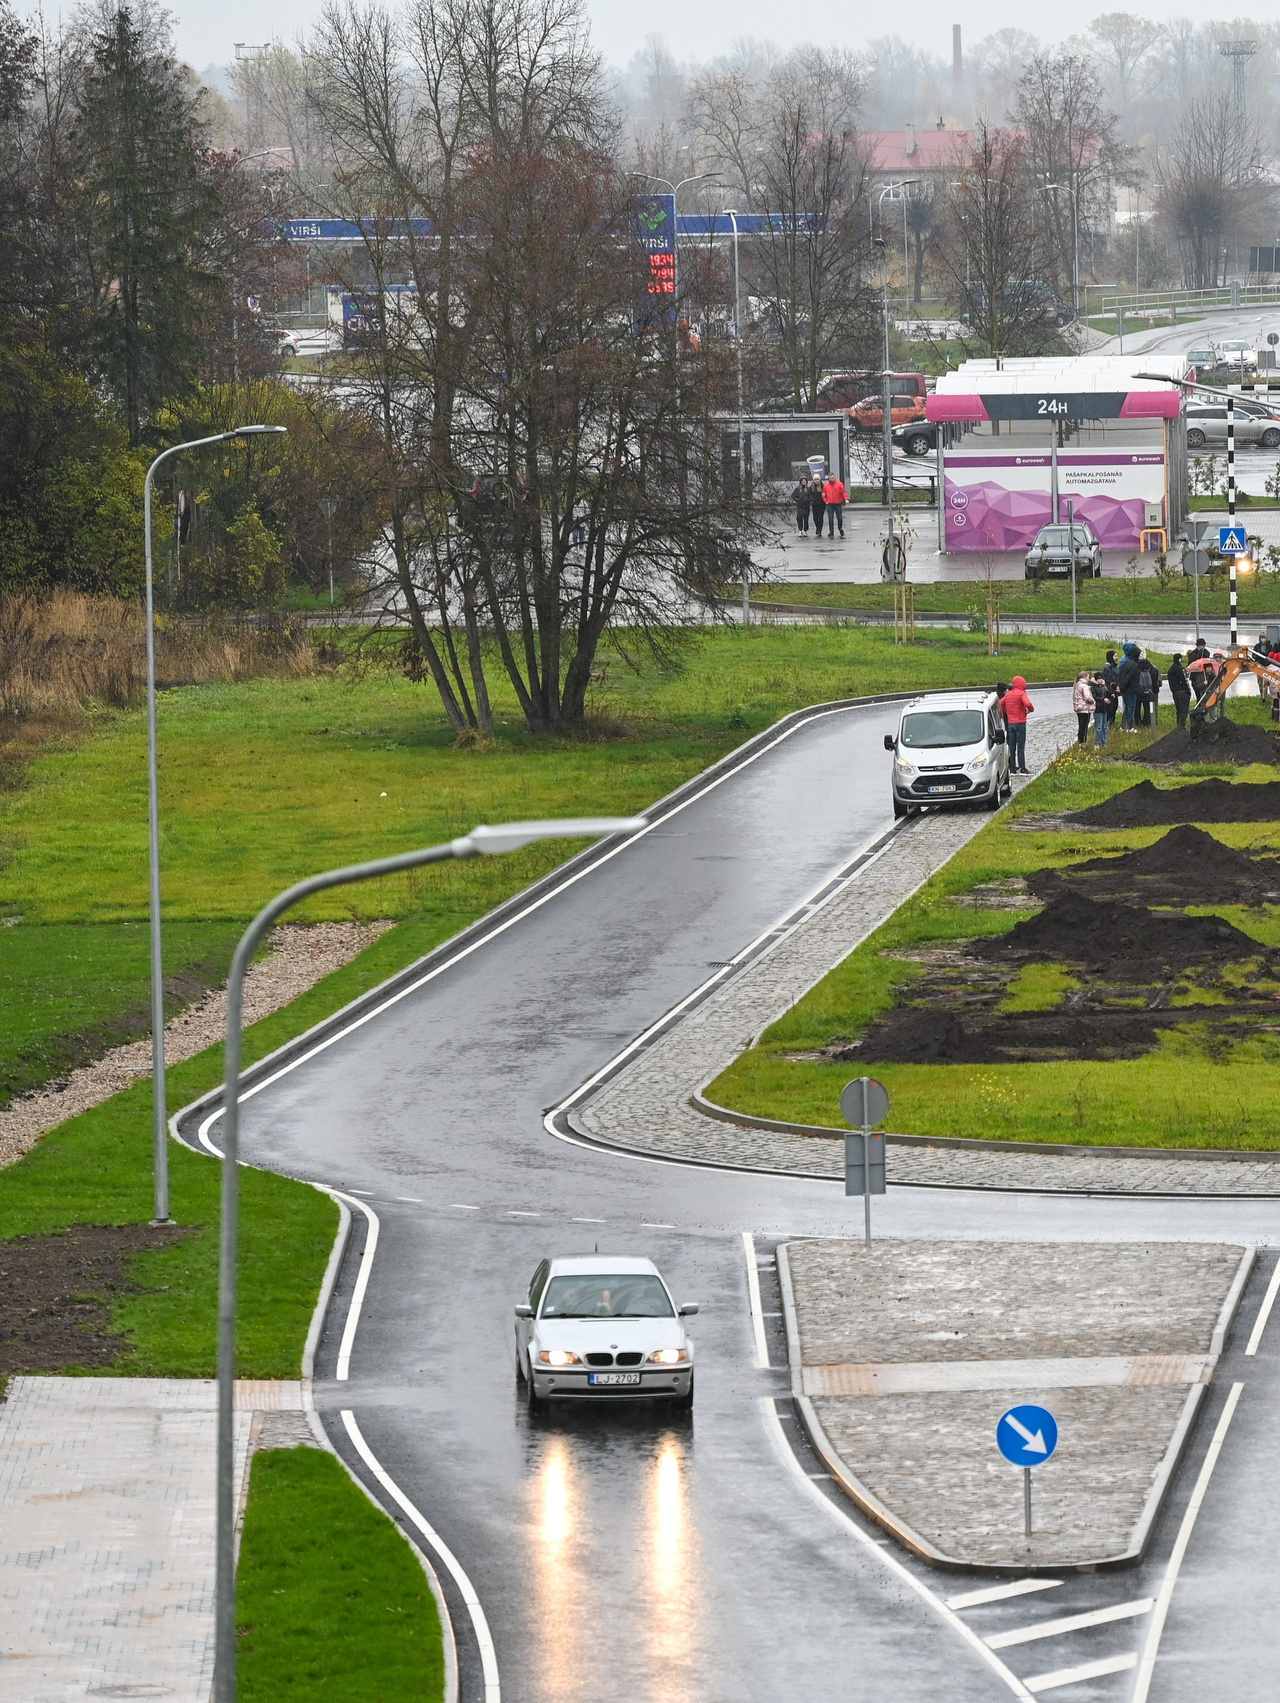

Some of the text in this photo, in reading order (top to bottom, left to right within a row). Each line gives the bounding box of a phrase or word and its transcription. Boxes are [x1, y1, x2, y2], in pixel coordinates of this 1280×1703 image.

[290, 223, 321, 236] VIRŠI
[1037, 399, 1068, 414] 24H
[1262, 672, 1280, 685] CASE
[596, 1374, 638, 1384] LJ-2702
